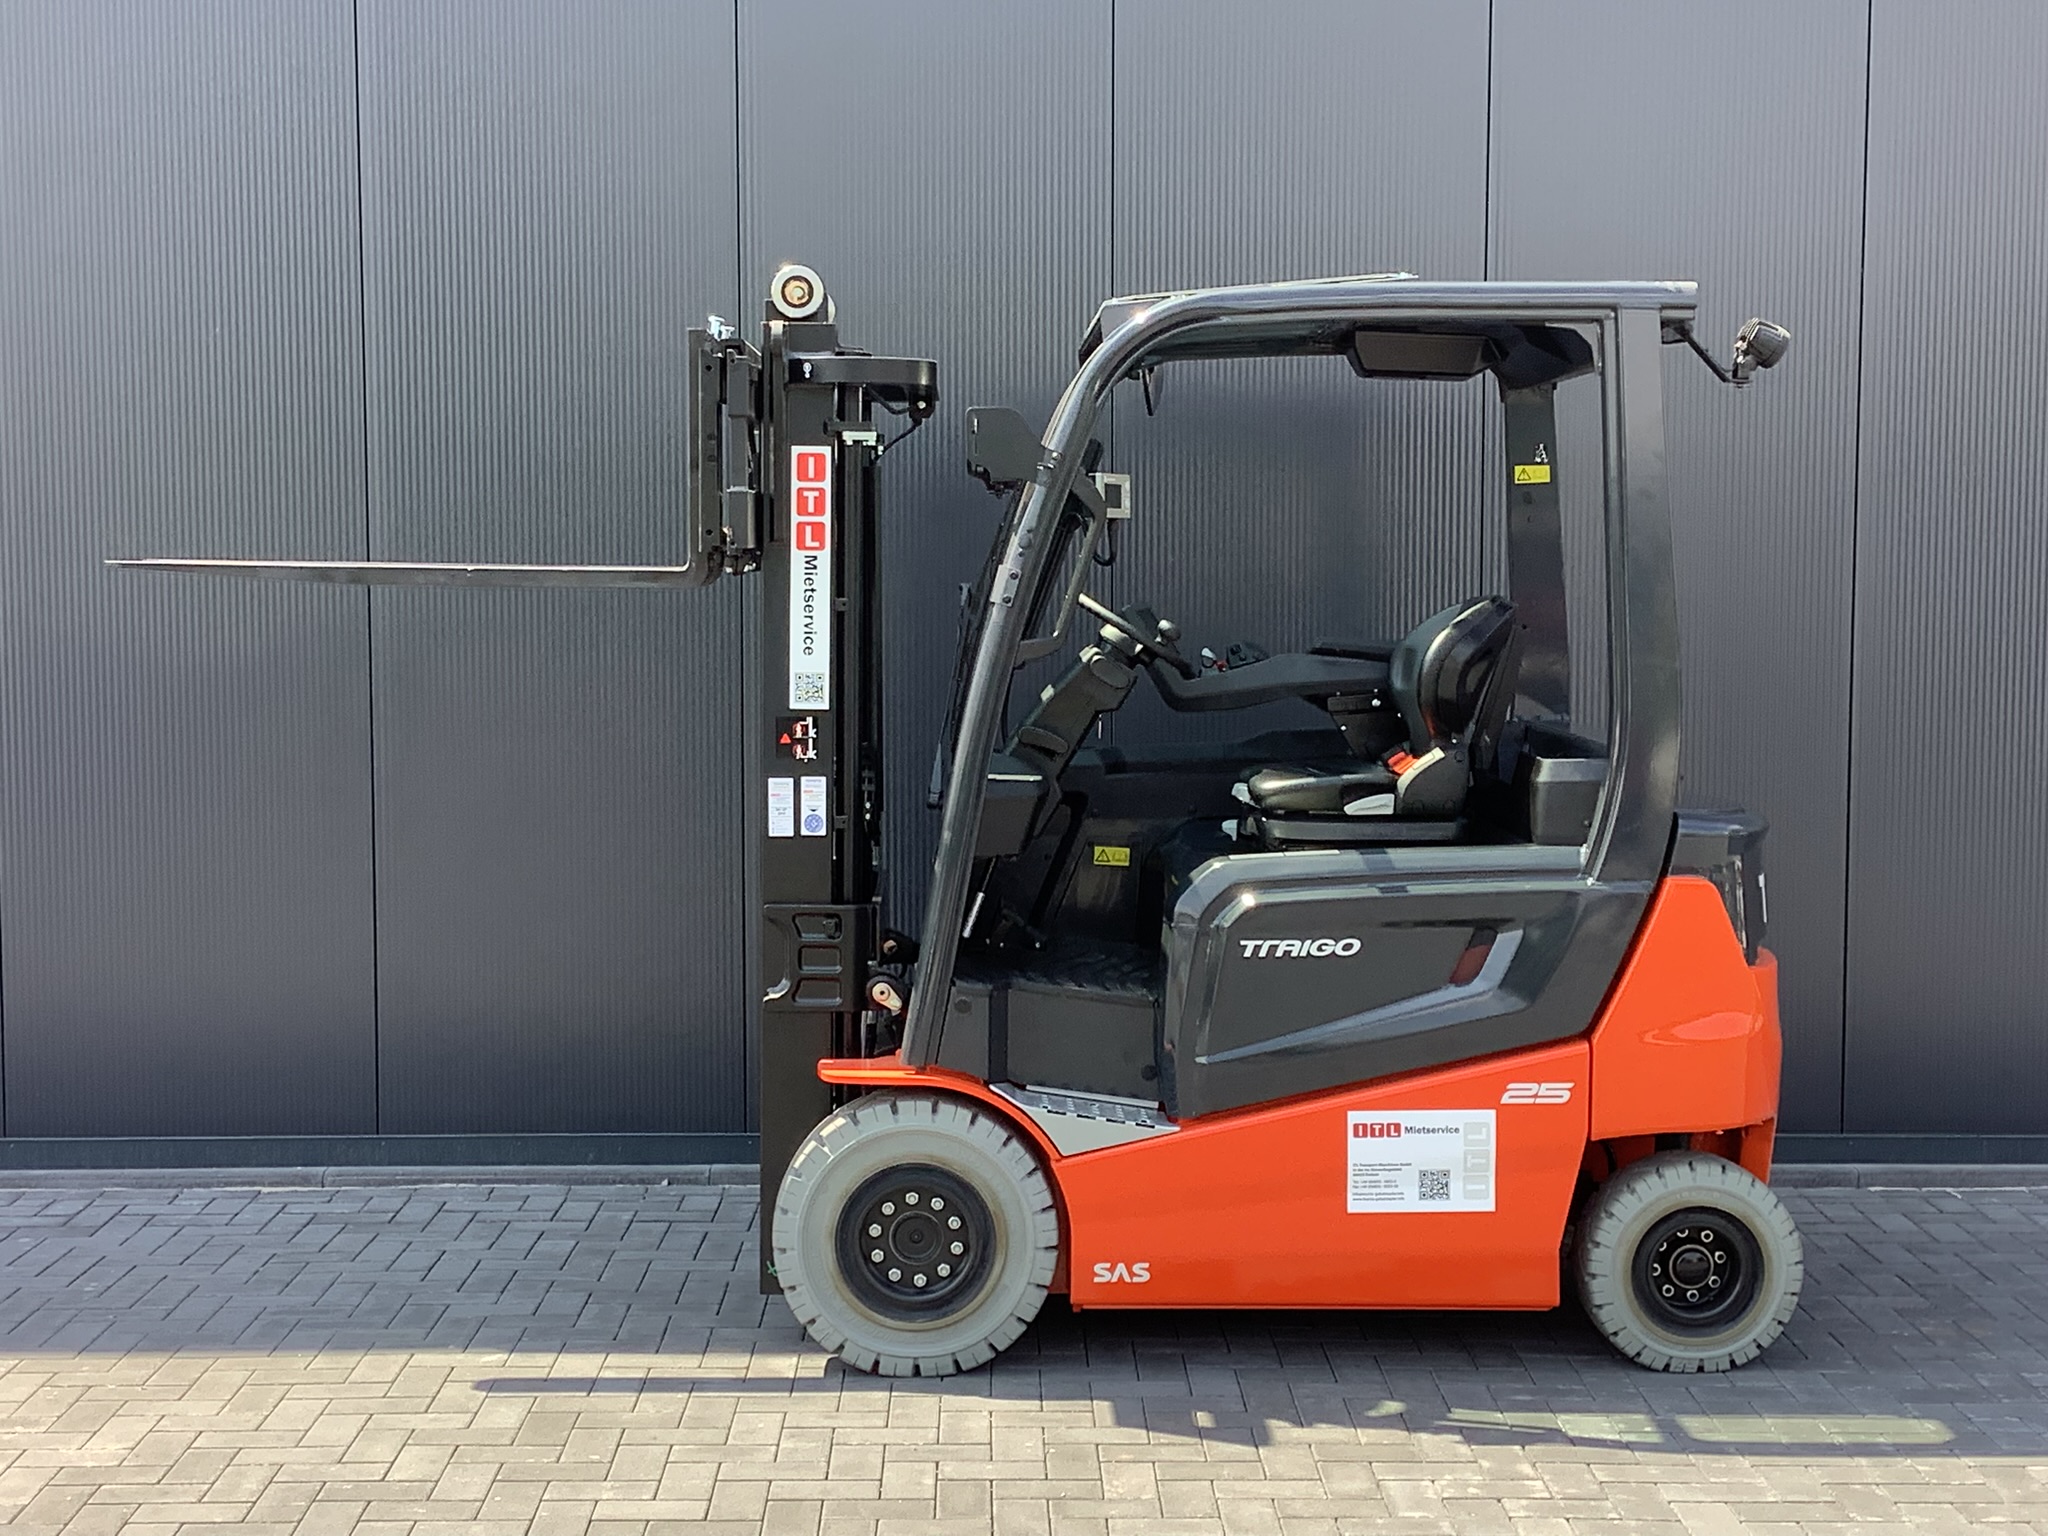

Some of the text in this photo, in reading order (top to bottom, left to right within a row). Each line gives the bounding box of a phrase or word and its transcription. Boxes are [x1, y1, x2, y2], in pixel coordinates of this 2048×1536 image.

[800, 455, 822, 656] ITL Mietservice
[1500, 1082, 1575, 1104] 25
[1355, 1124, 1460, 1137] ITL Mietservice
[1093, 1262, 1151, 1283] SAS
